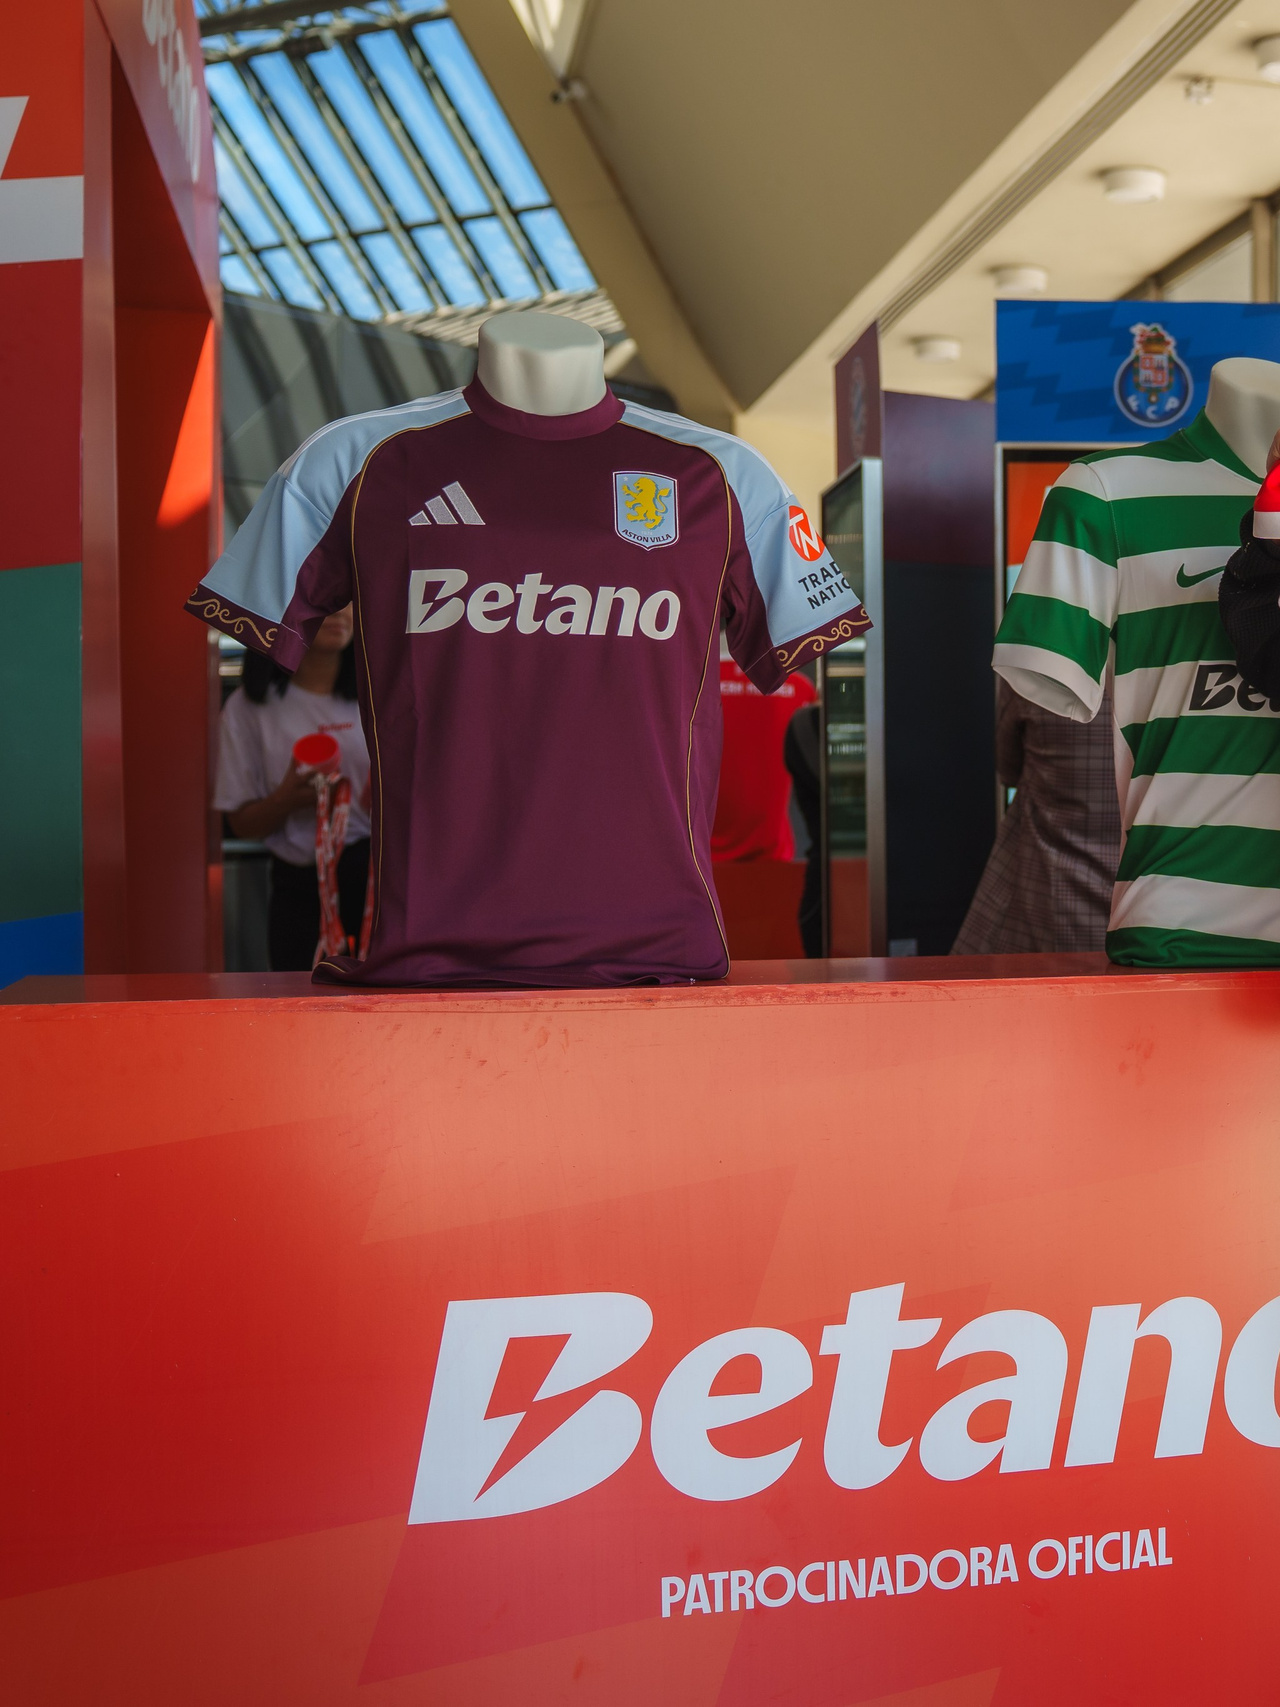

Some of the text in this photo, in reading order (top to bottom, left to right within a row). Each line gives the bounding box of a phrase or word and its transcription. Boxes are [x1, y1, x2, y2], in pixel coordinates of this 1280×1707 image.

[622, 528, 649, 543] ASTON
[650, 533, 672, 543] VILLA
[405, 568, 681, 640] Betano
[661, 1527, 1173, 1618] PATROCINADORA OFICIAL
